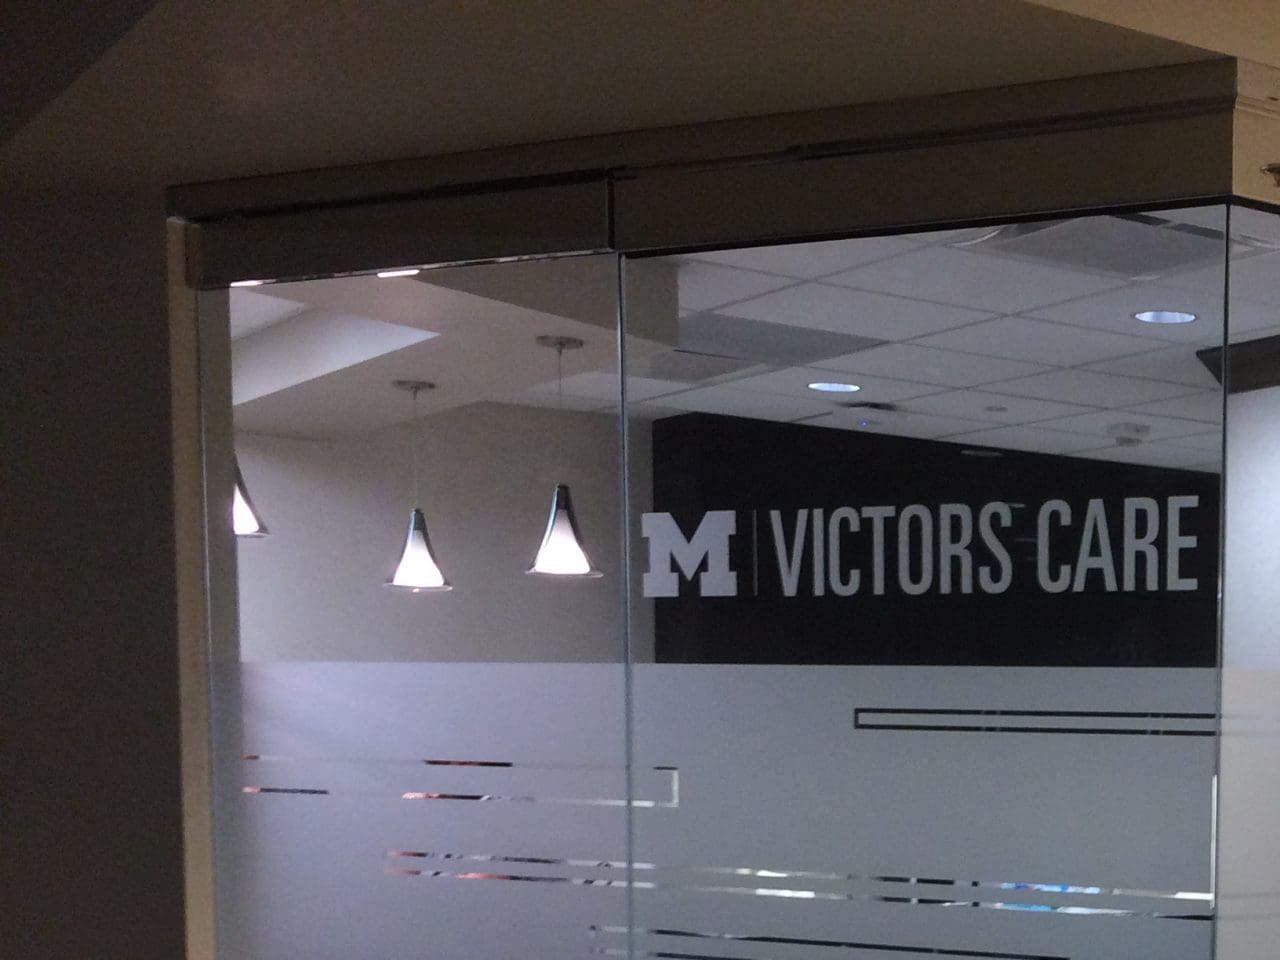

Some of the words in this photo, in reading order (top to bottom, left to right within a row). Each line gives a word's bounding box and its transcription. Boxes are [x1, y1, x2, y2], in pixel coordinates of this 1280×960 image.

[641, 509, 738, 597] M
[769, 501, 1013, 597] VICTORS
[1036, 495, 1199, 594] CARE
